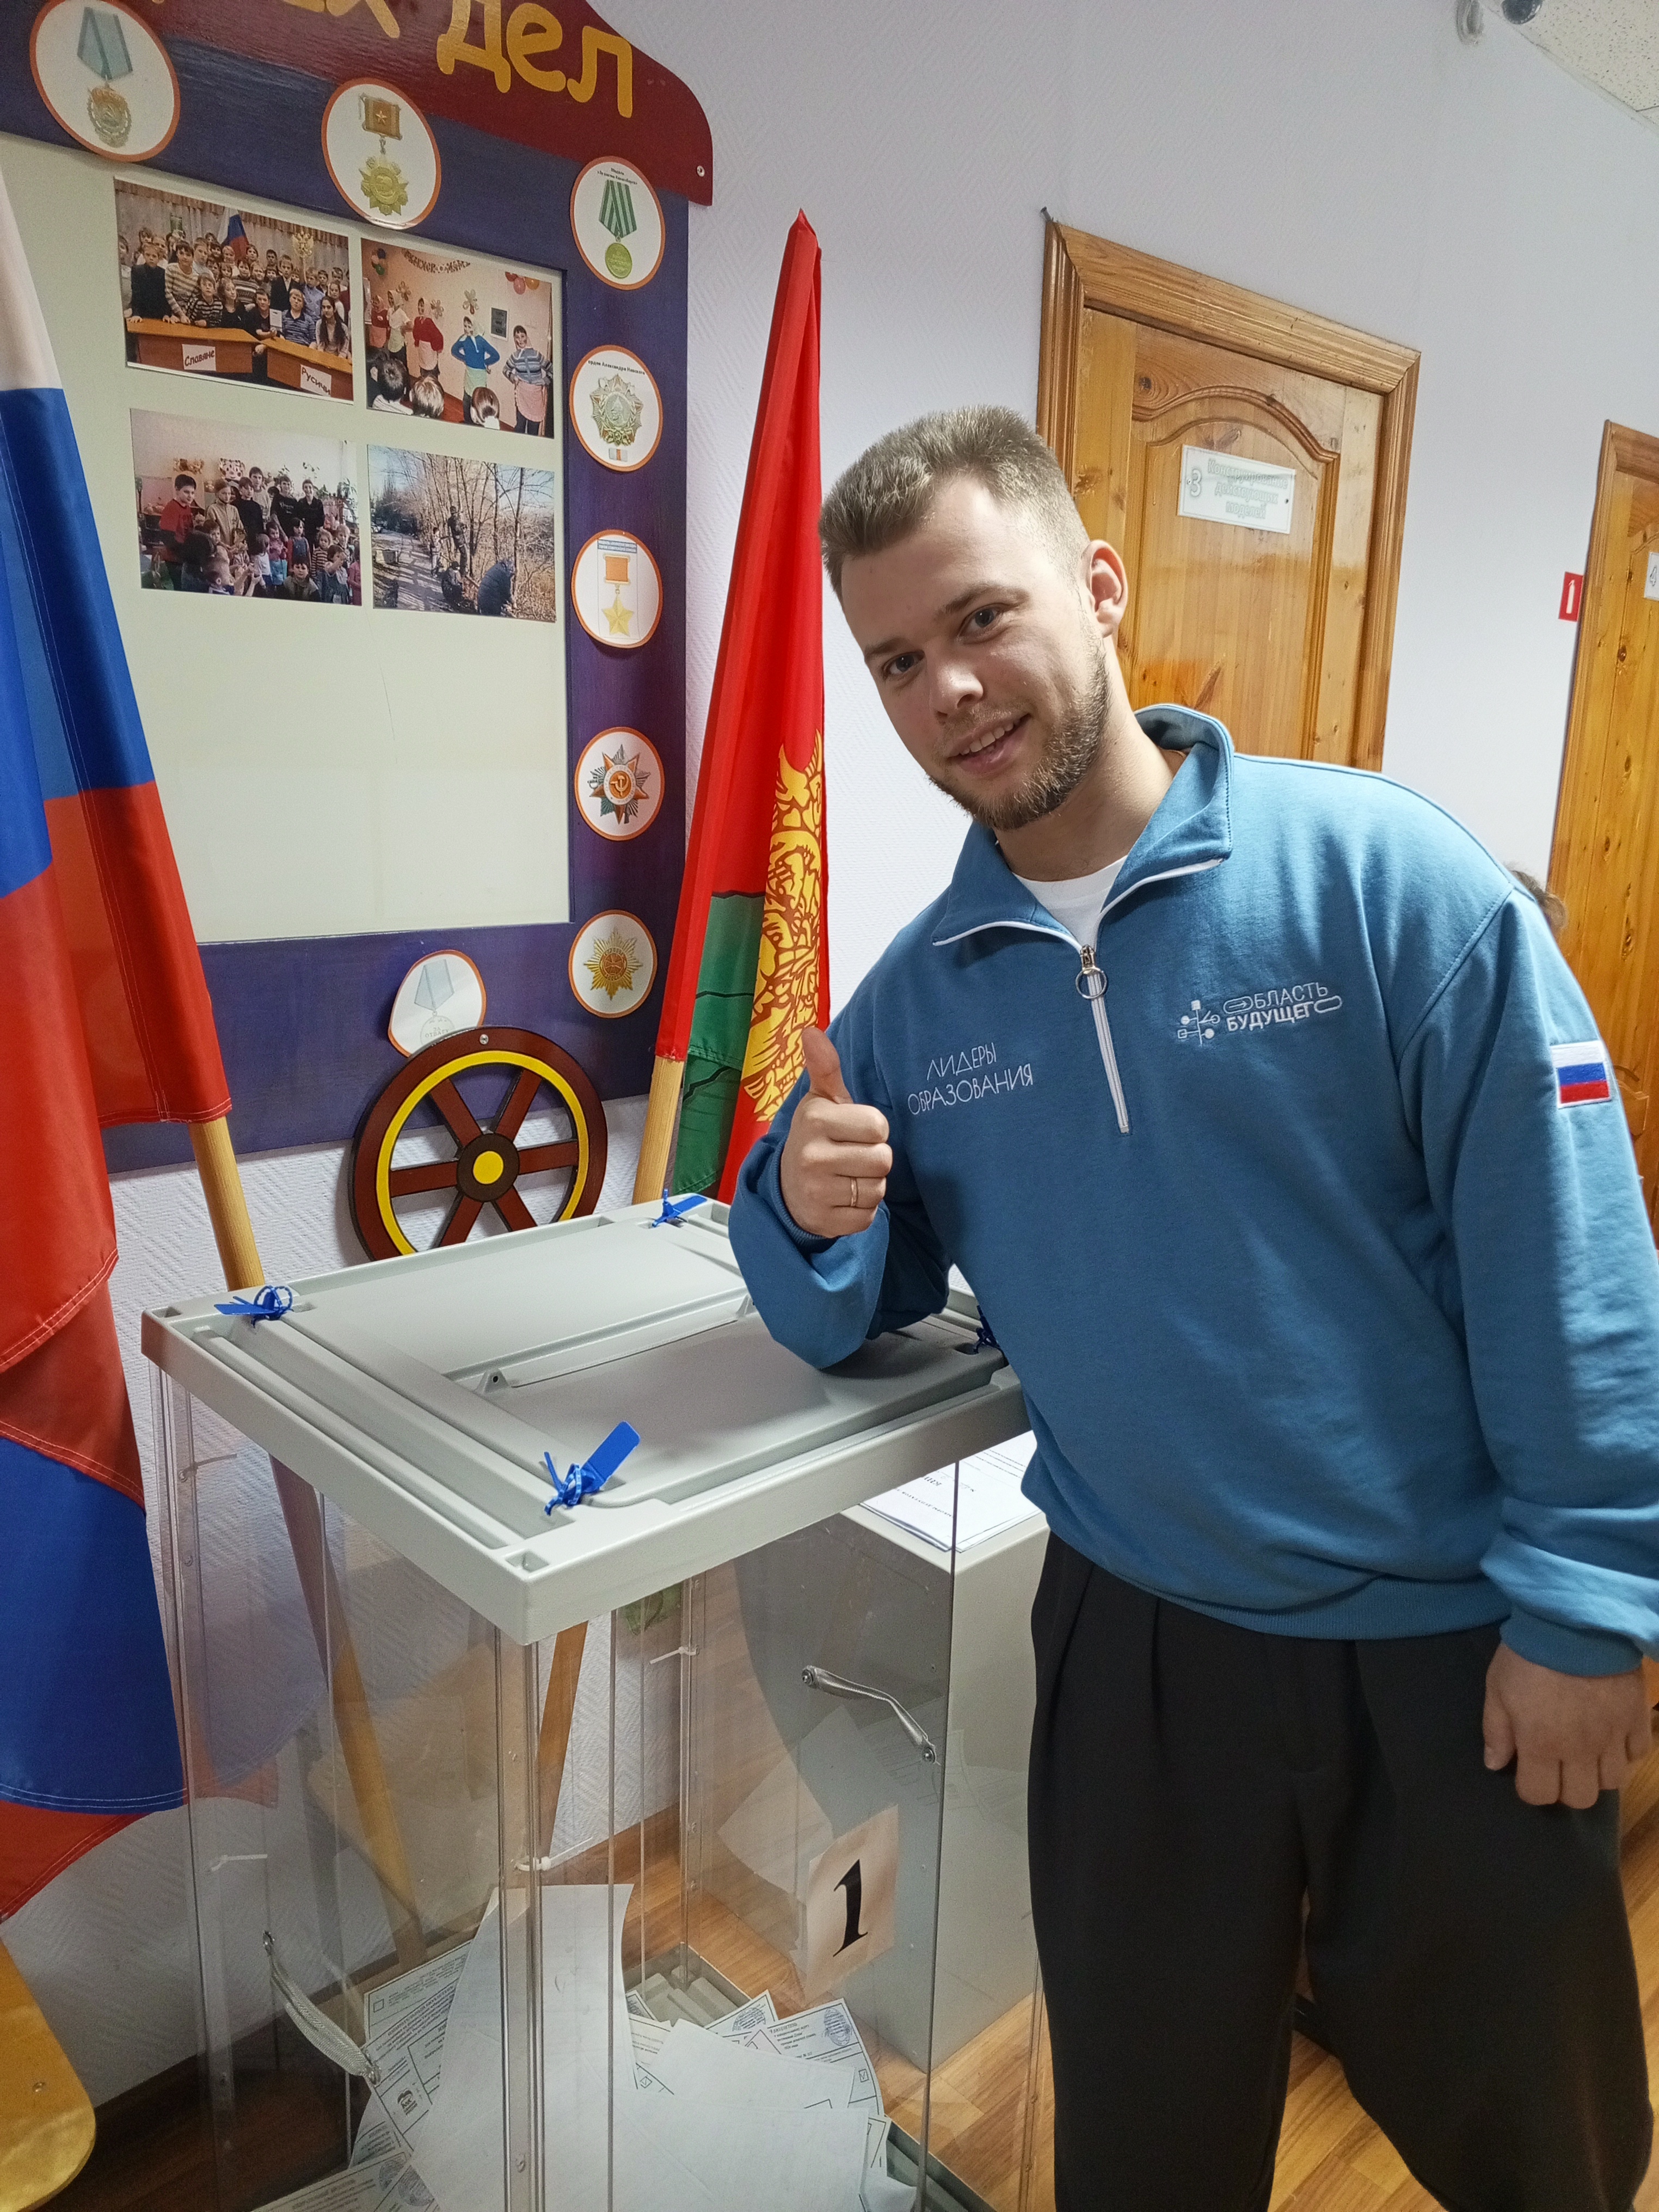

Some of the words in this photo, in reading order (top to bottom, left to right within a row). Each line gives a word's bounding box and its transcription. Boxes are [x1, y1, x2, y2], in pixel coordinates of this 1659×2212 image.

[184, 349, 215, 367] Славяне
[301, 366, 331, 396] Русичи
[1190, 468, 1202, 497] 3
[1207, 458, 1289, 489] Конструирование
[1214, 482, 1279, 504] действующих
[1225, 501, 1267, 519] моделей
[1649, 566, 1657, 586] 4
[1226, 995, 1343, 1032] БУДУЩЕГО
[926, 1042, 997, 1081] ЛИДЕРЫ
[907, 1063, 1034, 1115] ОБРАЗОВАНИЯ
[832, 1858, 869, 1958] 1
